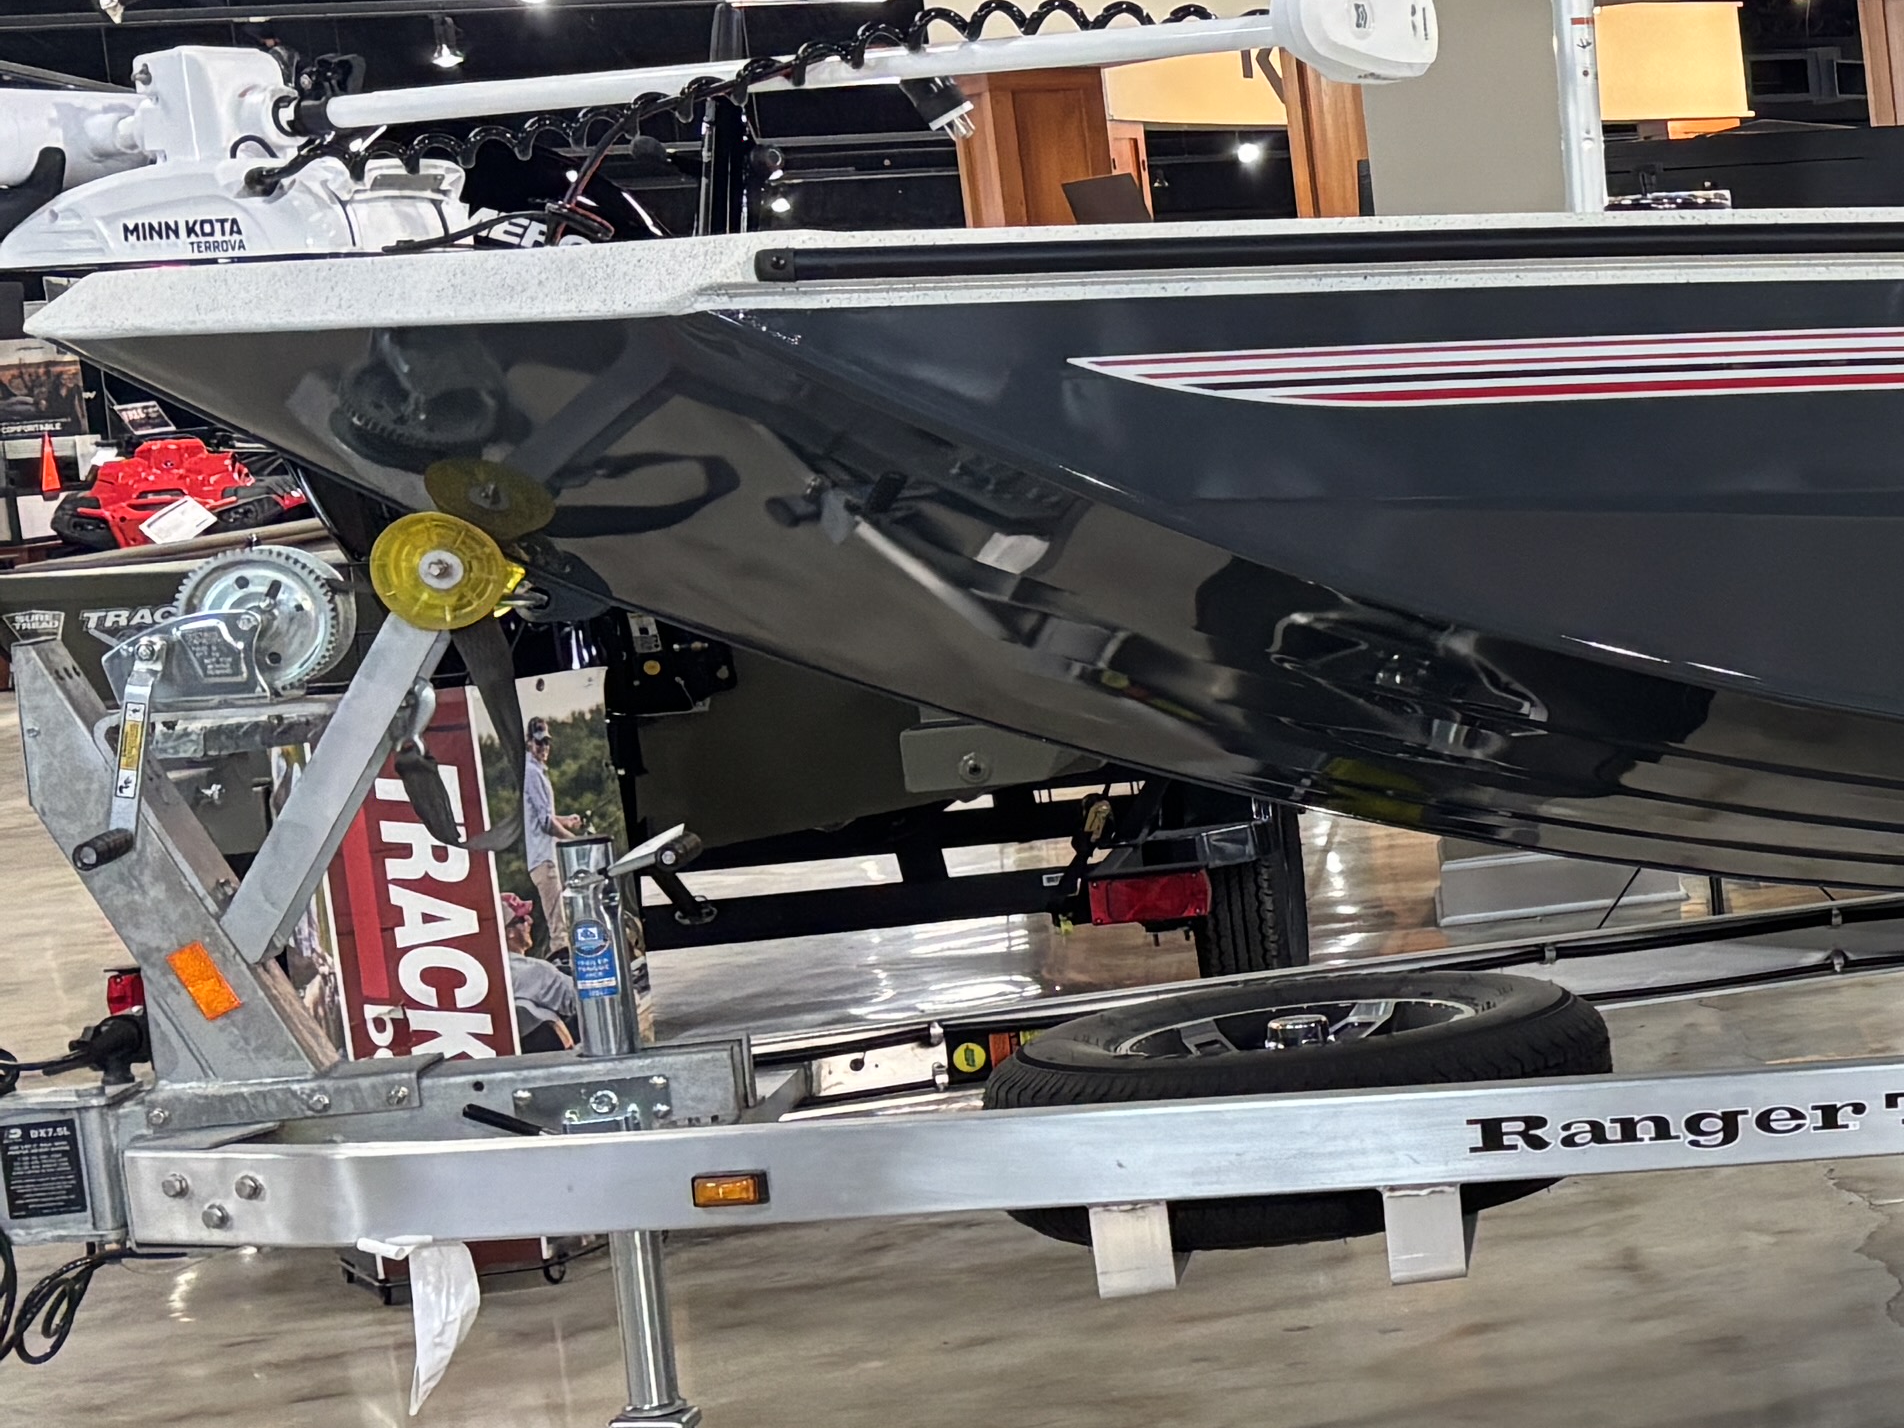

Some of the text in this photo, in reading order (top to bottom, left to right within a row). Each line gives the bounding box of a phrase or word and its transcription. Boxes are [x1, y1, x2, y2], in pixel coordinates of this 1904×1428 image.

[122, 217, 243, 242] MINN KOTA
[188, 238, 247, 254] TERROVA
[82, 606, 178, 630] TRAC
[374, 763, 498, 1060] TRACK
[1465, 1099, 1868, 1155] Ranger
